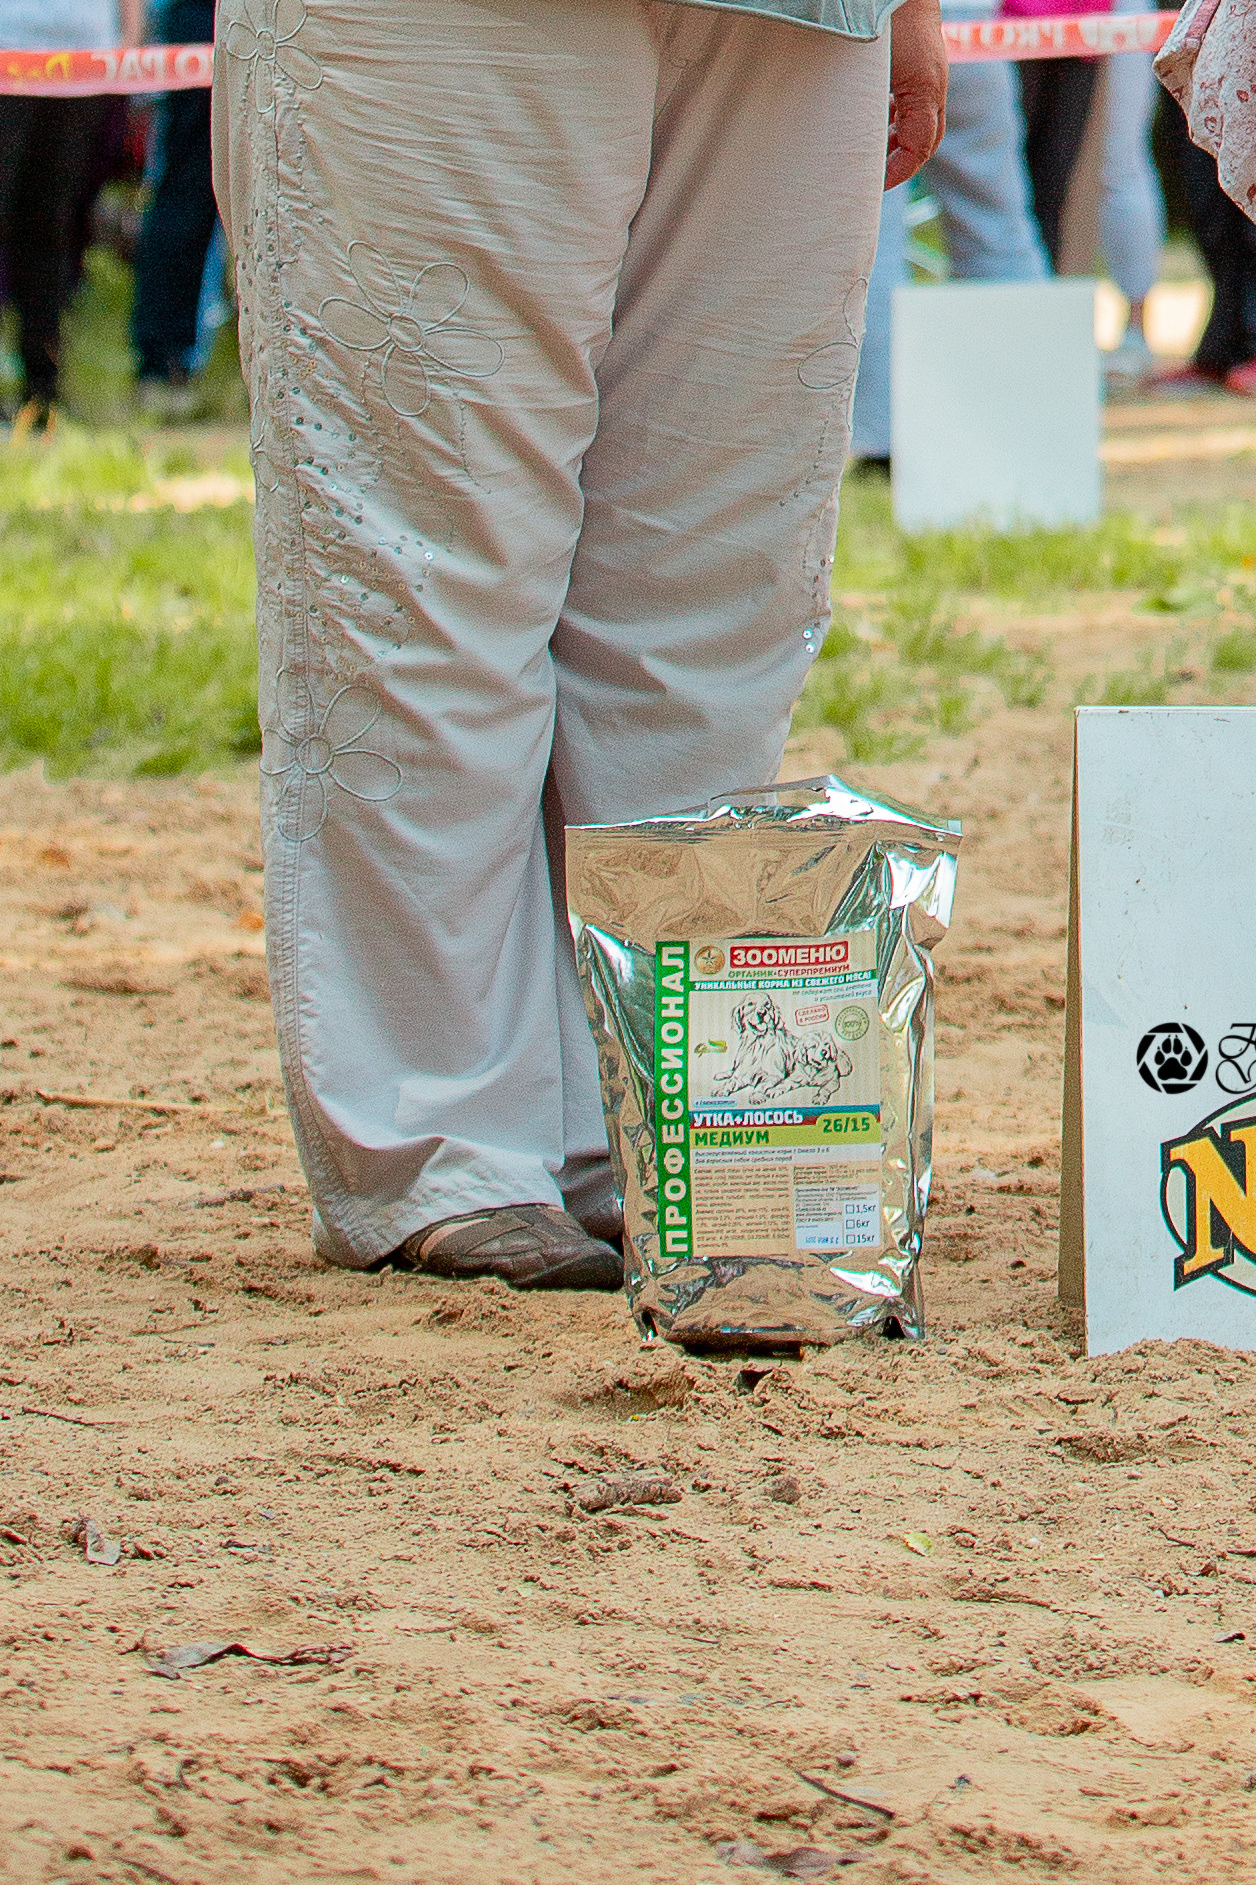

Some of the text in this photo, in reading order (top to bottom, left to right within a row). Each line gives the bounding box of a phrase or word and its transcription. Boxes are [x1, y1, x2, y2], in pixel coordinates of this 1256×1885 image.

[732, 944, 847, 965] ЗООМЕНЮ
[694, 981, 757, 990] УНИКАЛЬНЫЕ
[758, 979, 790, 988] КОРМА
[791, 978, 803, 987] ИЗ
[805, 974, 844, 986] СВЕЖЕГО
[660, 945, 688, 1253] ПРОФЕССИОНАЛ
[694, 1110, 803, 1127] УТКА+ЛОСОСЬ
[823, 1117, 870, 1133] 26/15
[694, 1130, 769, 1147] МЕДИУМ
